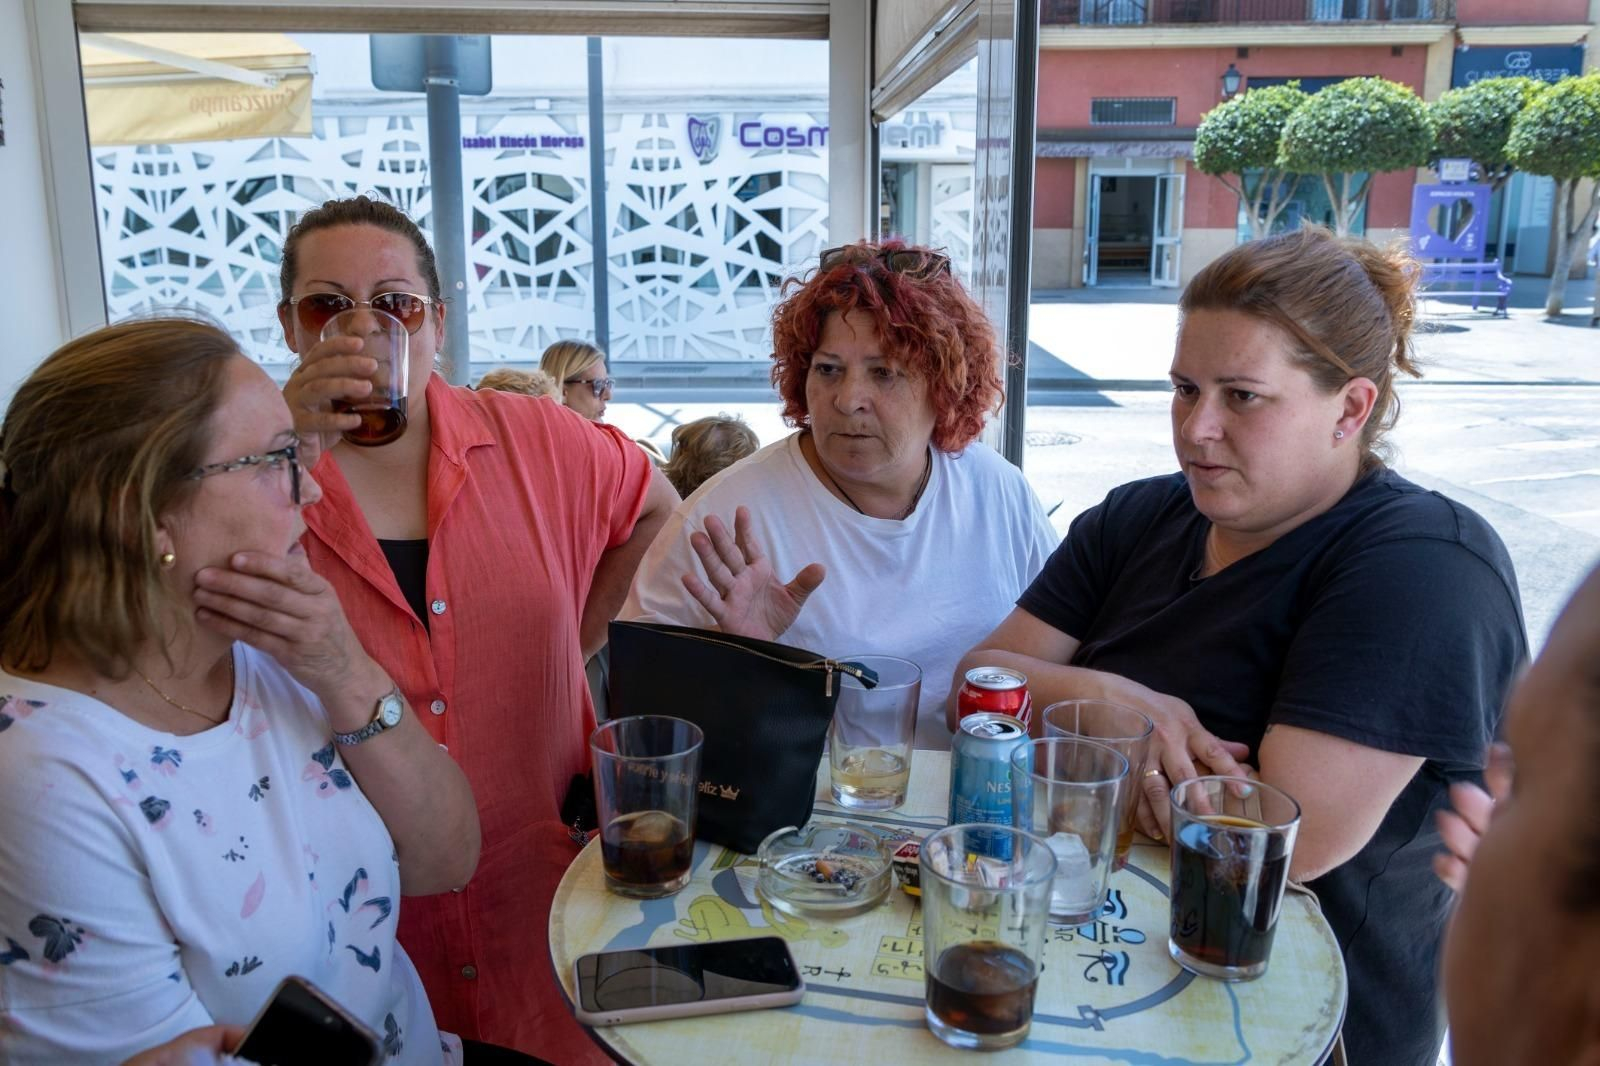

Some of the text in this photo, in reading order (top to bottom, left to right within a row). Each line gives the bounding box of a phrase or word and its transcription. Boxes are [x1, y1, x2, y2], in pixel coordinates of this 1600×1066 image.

[462, 136, 496, 148] Isabel
[499, 135, 537, 148] Rincón
[880, 119, 945, 146] ent
